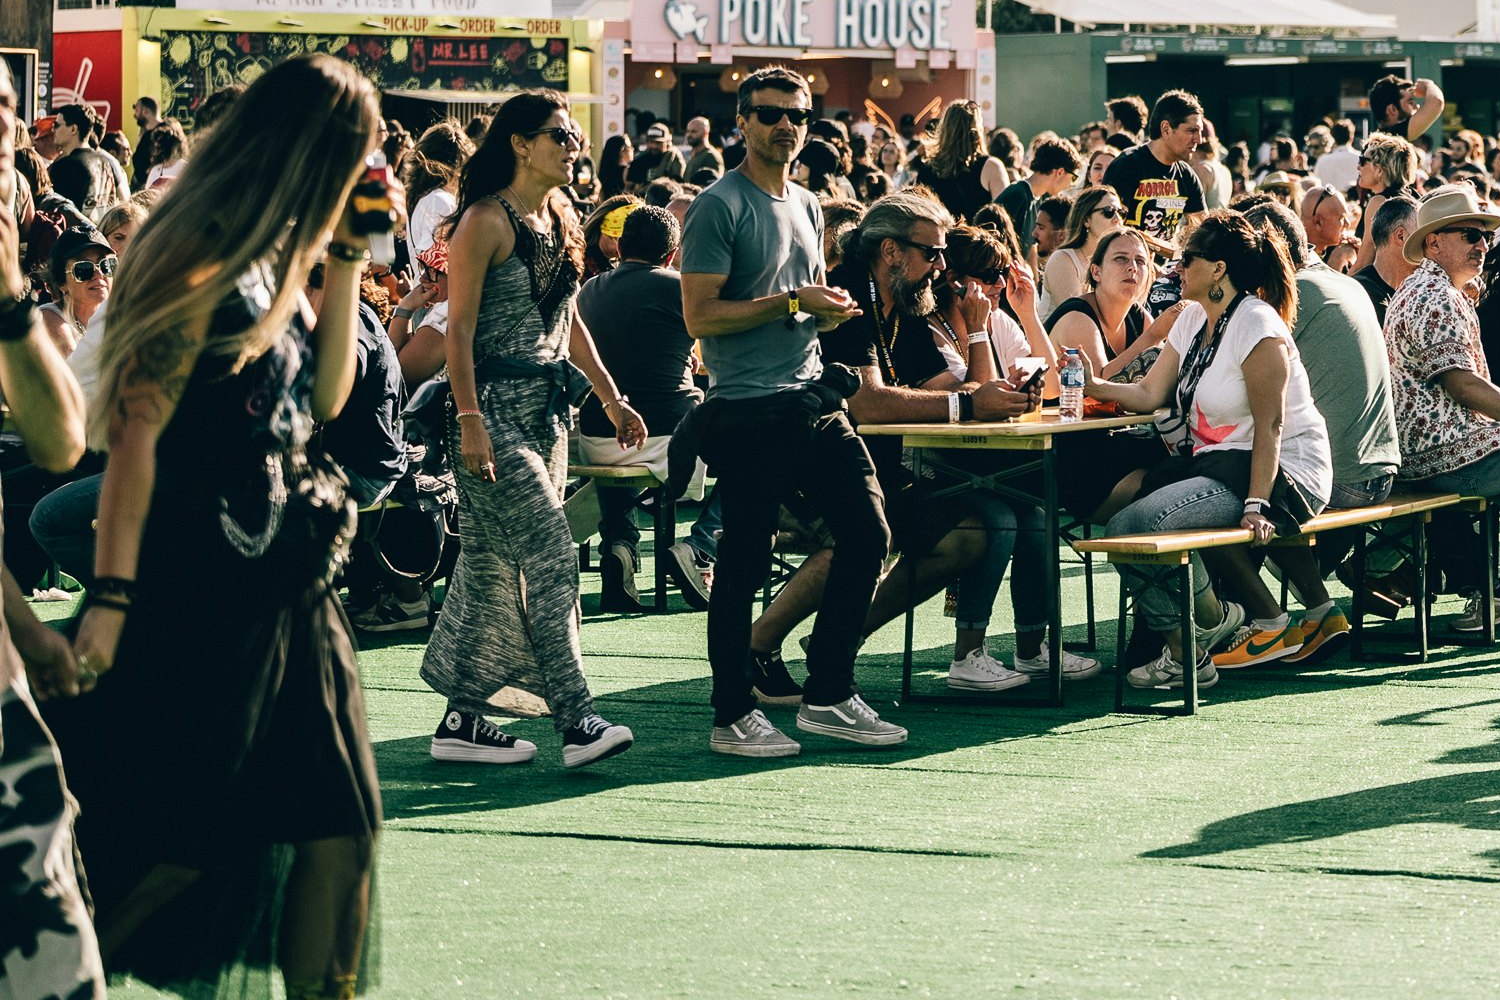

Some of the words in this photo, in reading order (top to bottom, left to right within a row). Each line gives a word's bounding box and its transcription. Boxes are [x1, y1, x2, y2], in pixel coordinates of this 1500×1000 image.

[383, 17, 429, 33] PICK-UP
[459, 18, 496, 34] ORDER
[526, 20, 562, 34] ORDER
[1136, 180, 1177, 197] HORROR
